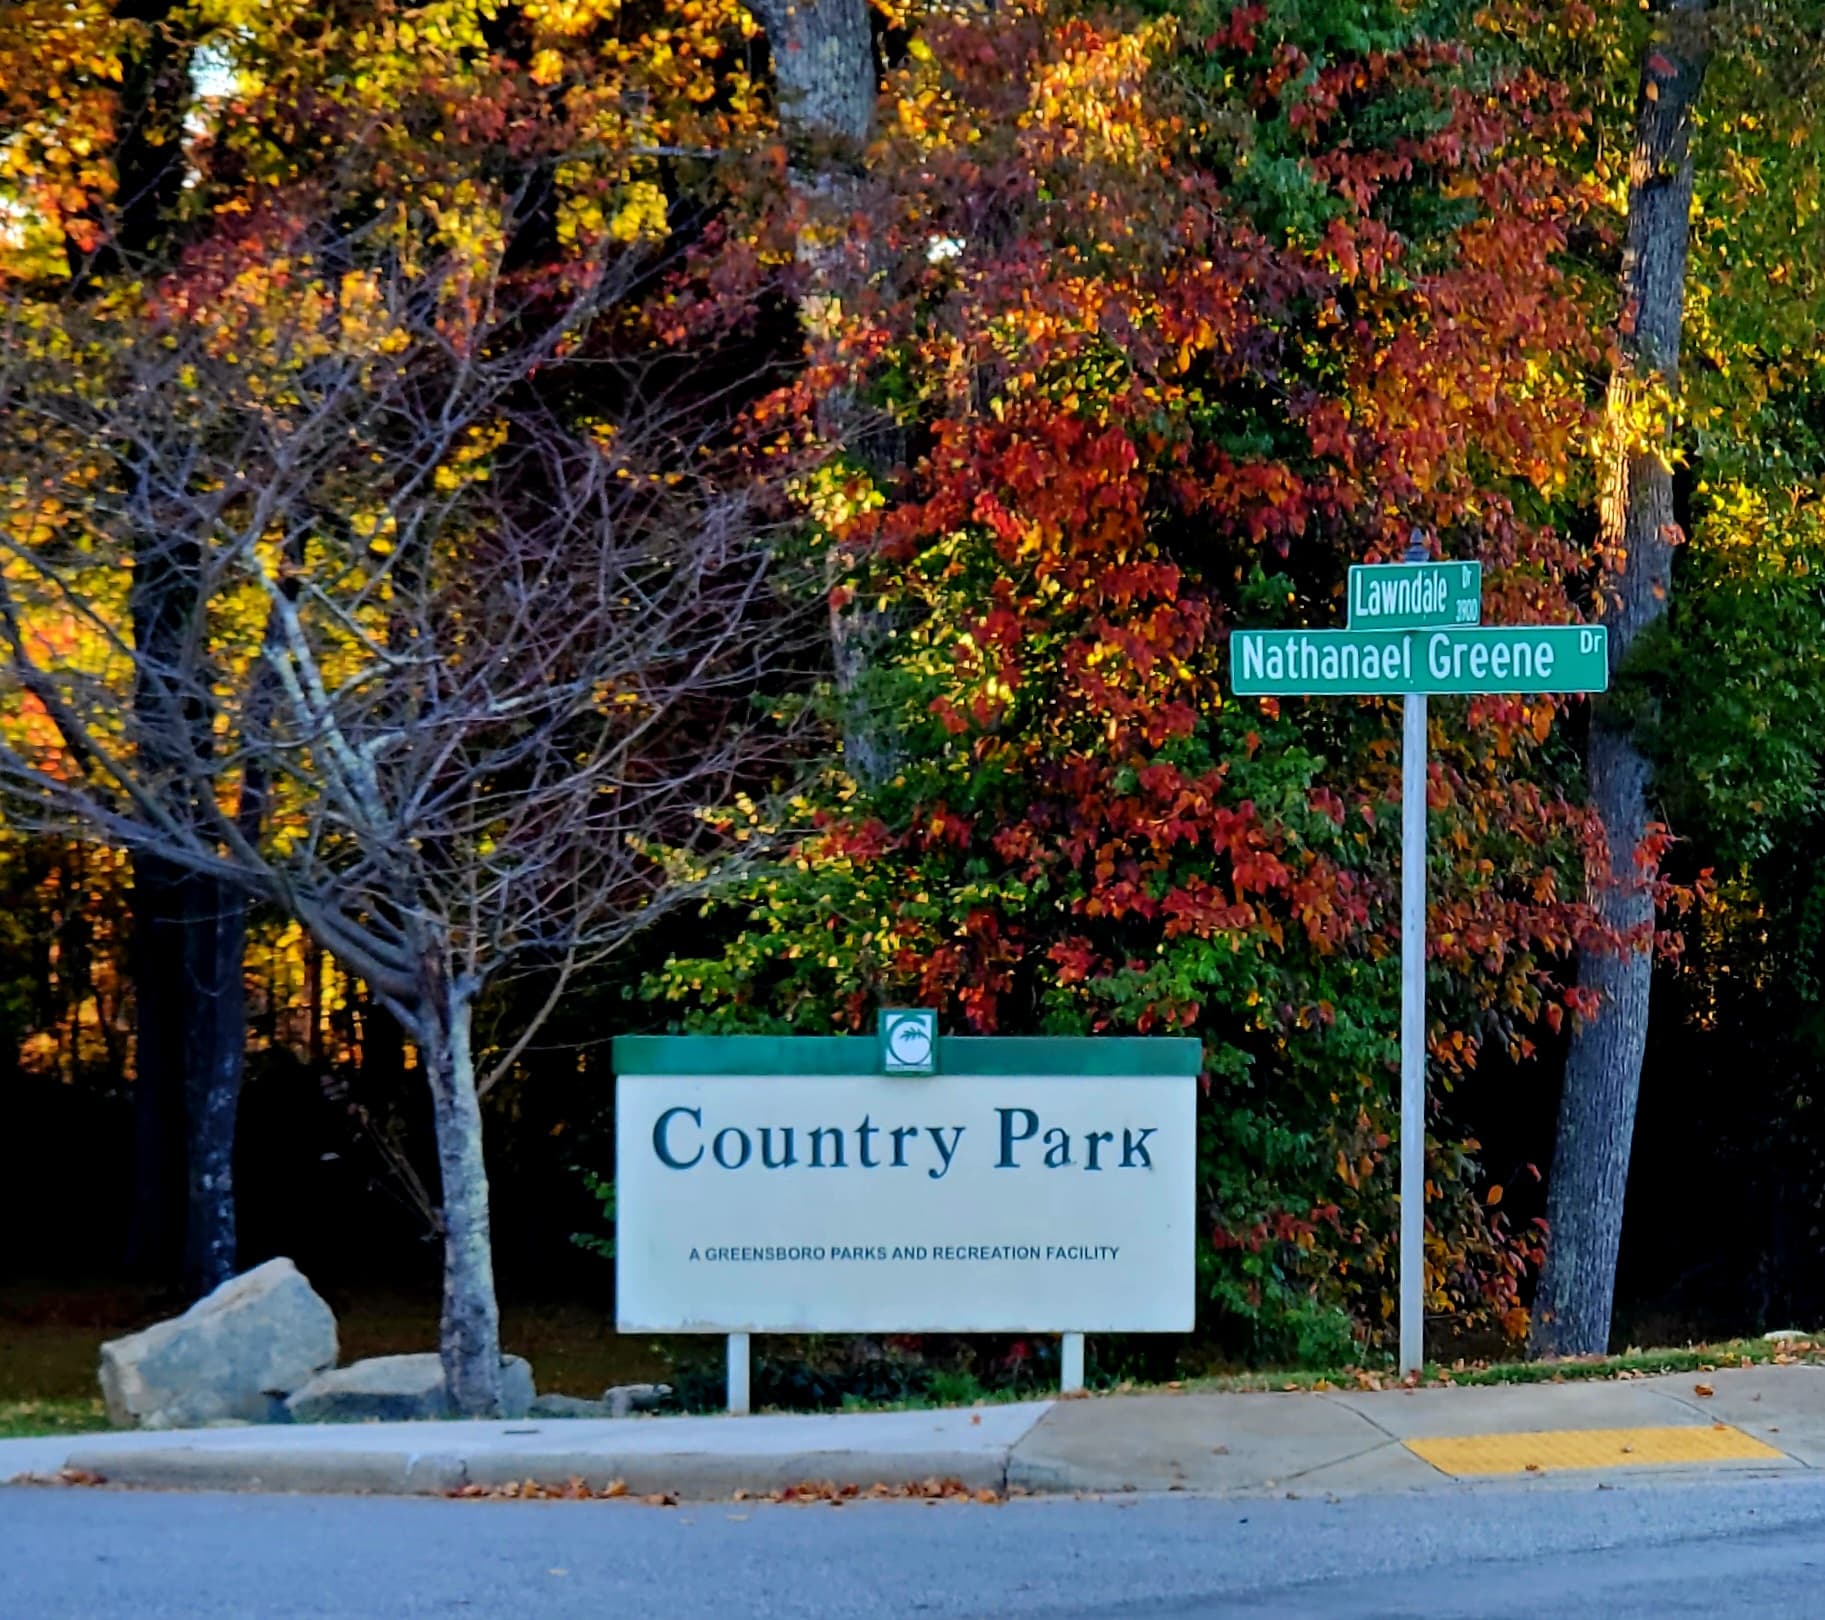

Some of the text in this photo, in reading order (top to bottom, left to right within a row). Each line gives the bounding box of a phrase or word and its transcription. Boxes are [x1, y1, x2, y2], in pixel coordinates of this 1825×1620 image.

[1355, 564, 1473, 617] Lawndale Dr
[1242, 629, 1602, 680] Nathanael Greene Dr
[652, 1105, 1159, 1180] Country Park
[689, 1246, 1120, 1262] A GREENSBORO PARKS AND RECREATION FACILITY
